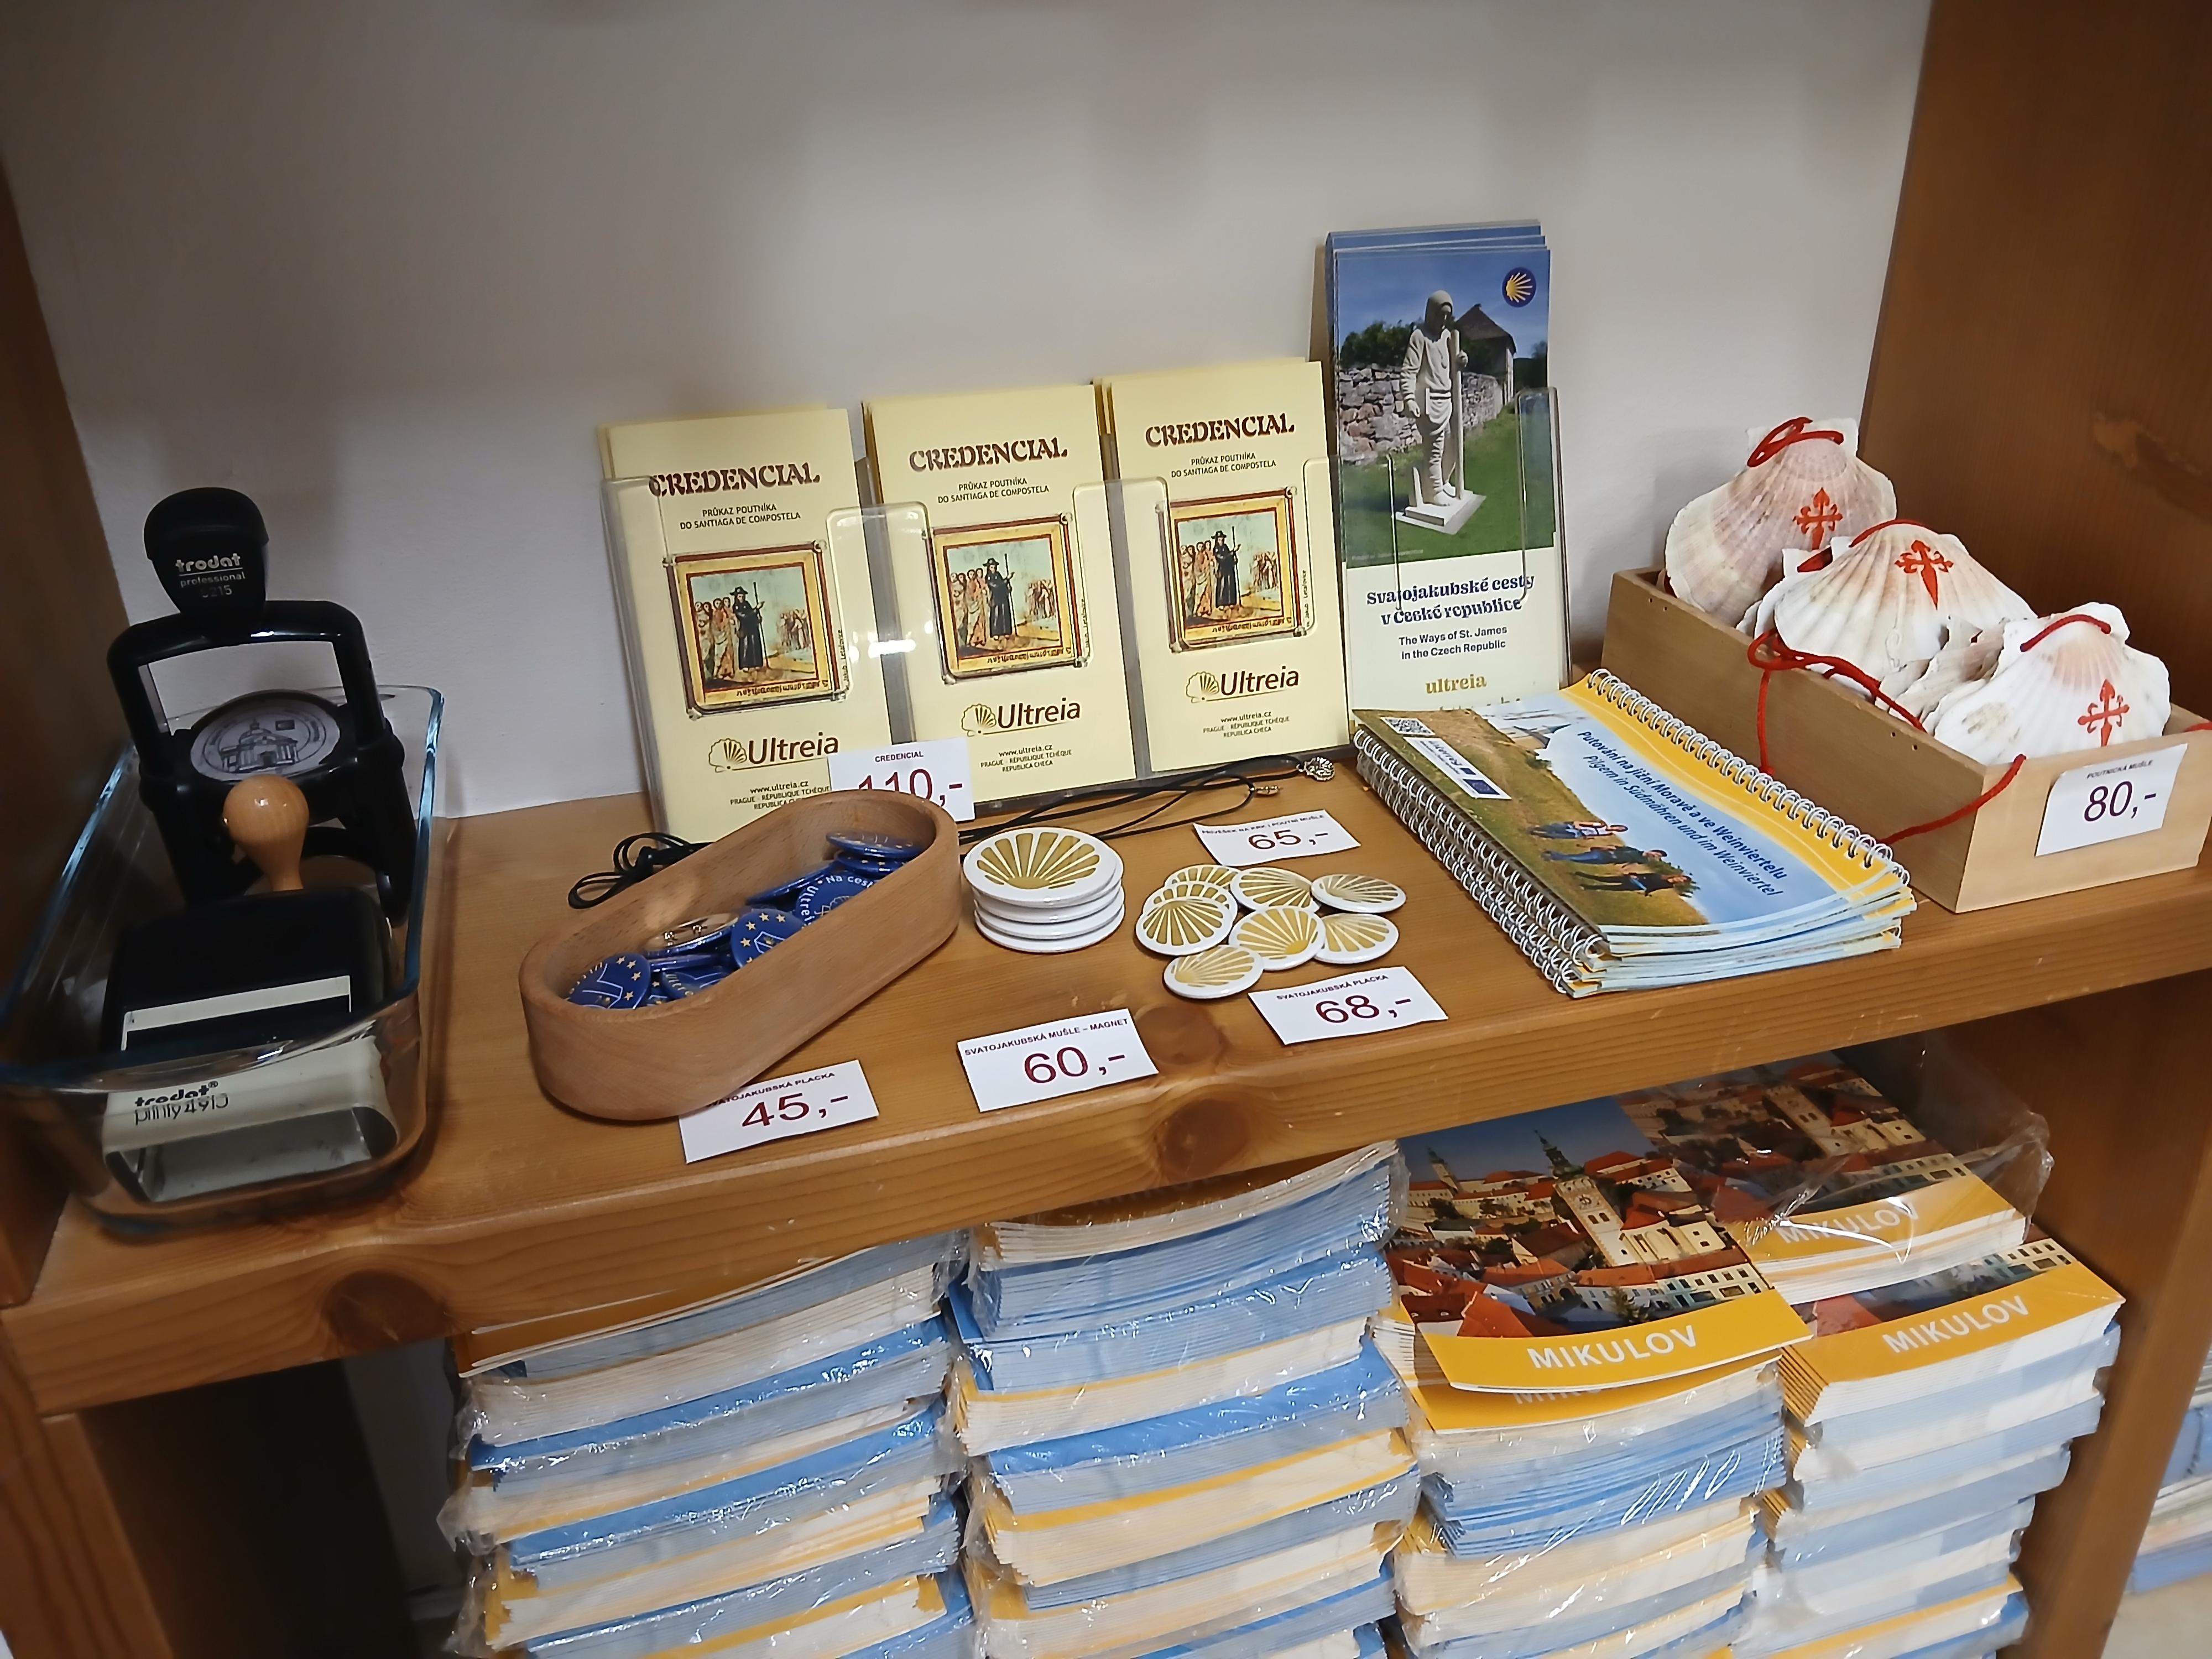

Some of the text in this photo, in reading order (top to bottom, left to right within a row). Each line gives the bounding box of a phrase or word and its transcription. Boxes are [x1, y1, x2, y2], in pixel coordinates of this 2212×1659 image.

[1145, 413, 1295, 447] CREDENCIAL
[909, 437, 1067, 472] CREDENCIAL
[1191, 451, 1256, 466] PRŮKAZ POUTNÍKA
[649, 463, 820, 497] CREDENCIAL
[1171, 460, 1276, 478] DO SANTIAGA DE COMPOSTELA
[938, 486, 1049, 504] DO SANTIAGA DE COMPOSTELA
[958, 477, 1027, 491] PRŮKAZ POUTNÍKA
[694, 518, 734, 529] SANTIAGA
[748, 512, 801, 523] COMPOSTELA
[702, 503, 776, 517] PRŮKAZ POUTNÍKA
[175, 553, 241, 572] trodat
[1367, 575, 1535, 605] Svatojakubské cesty
[1381, 598, 1522, 625] v České republice
[1399, 627, 1507, 645] The Ways of St. James
[1413, 649, 1428, 658] the
[1431, 645, 1461, 656] Czech
[1463, 640, 1506, 653] Republic
[1220, 665, 1299, 696] Ultreia
[1426, 674, 1487, 694] ultreia
[998, 697, 1081, 729] Ultreia
[1221, 711, 1271, 723] www.ultreia.cz
[748, 732, 838, 765] Ultreia
[875, 750, 924, 762] CREDENCIAL
[999, 745, 1053, 757] www.ultreia.cz
[980, 759, 1004, 768] PRAGUE
[730, 796, 755, 805] PRAGUE
[750, 781, 808, 794] www.ultreia.cz
[858, 769, 962, 807] 110,-
[2084, 781, 2157, 822] 80,-
[1577, 731, 1625, 760] Putování
[1616, 760, 1634, 769] na
[1625, 768, 1661, 785] jižní
[1651, 784, 1696, 812] Moravě
[1698, 817, 1715, 827] ve
[1713, 826, 1787, 879] Weinviertelu
[1583, 755, 1619, 778] Pilgern
[1624, 785, 1682, 825] Südmähren
[1677, 825, 1707, 840] und
[1698, 839, 1717, 851] im
[1713, 850, 1783, 895] Weinviertel
[1248, 830, 1328, 849] 65,-
[825, 875, 874, 888] Na cest
[799, 885, 818, 926] Ultrei
[1276, 974, 1389, 1000] SVATOJAKUBSKÁ PLACKA
[1316, 994, 1411, 1023] 68,-
[964, 1032, 1047, 1056] SVATOJAKUBSKÁ
[1048, 1026, 1081, 1039] MUŠLE
[1089, 1018, 1128, 1031] MAGNET
[1024, 1046, 1125, 1084] 60,-
[711, 1072, 835, 1107] VATOJAKUBSKÁ PLACKA
[742, 1092, 848, 1128] 45,-
[1777, 1202, 1919, 1244] MIKULOV
[1882, 1295, 2030, 1354] MIKULOV
[1527, 1325, 1697, 1369] MIKULOV
